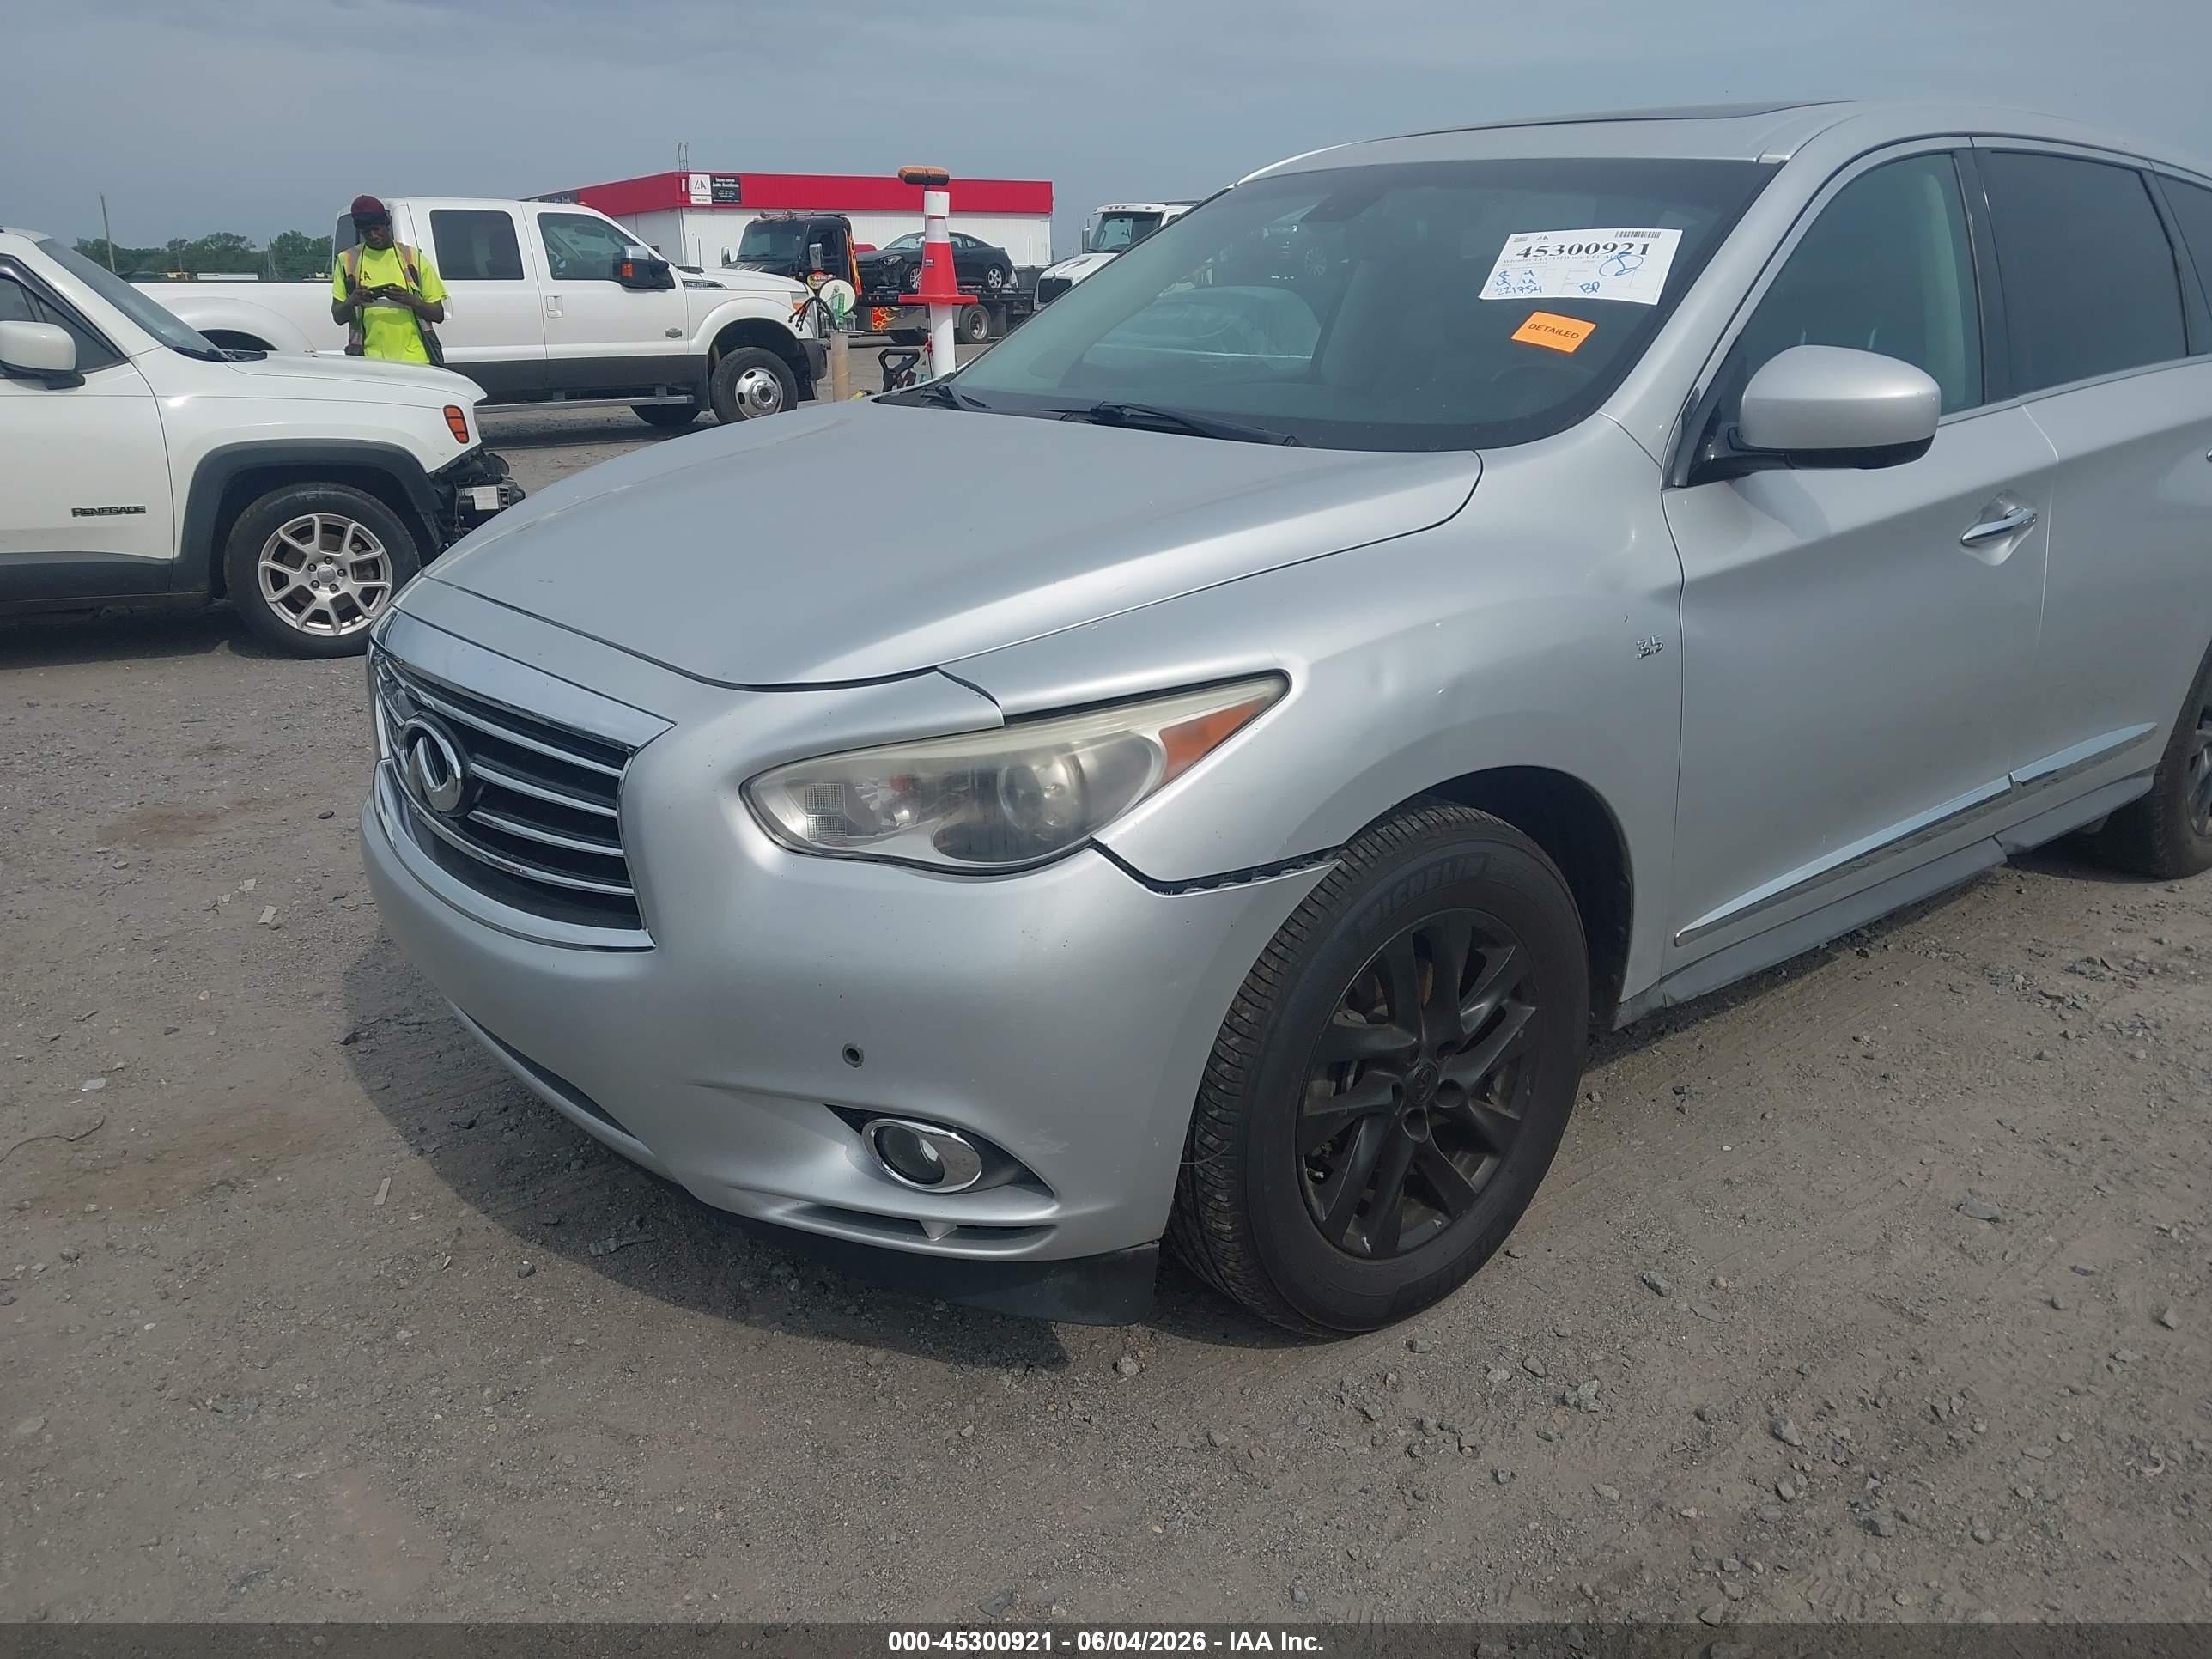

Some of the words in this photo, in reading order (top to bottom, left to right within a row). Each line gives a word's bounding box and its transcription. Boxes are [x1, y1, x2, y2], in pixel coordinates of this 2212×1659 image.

[1516, 241, 1650, 259] 45300921
[1528, 322, 1580, 340] DETAILED
[71, 505, 147, 518] RENEGADE
